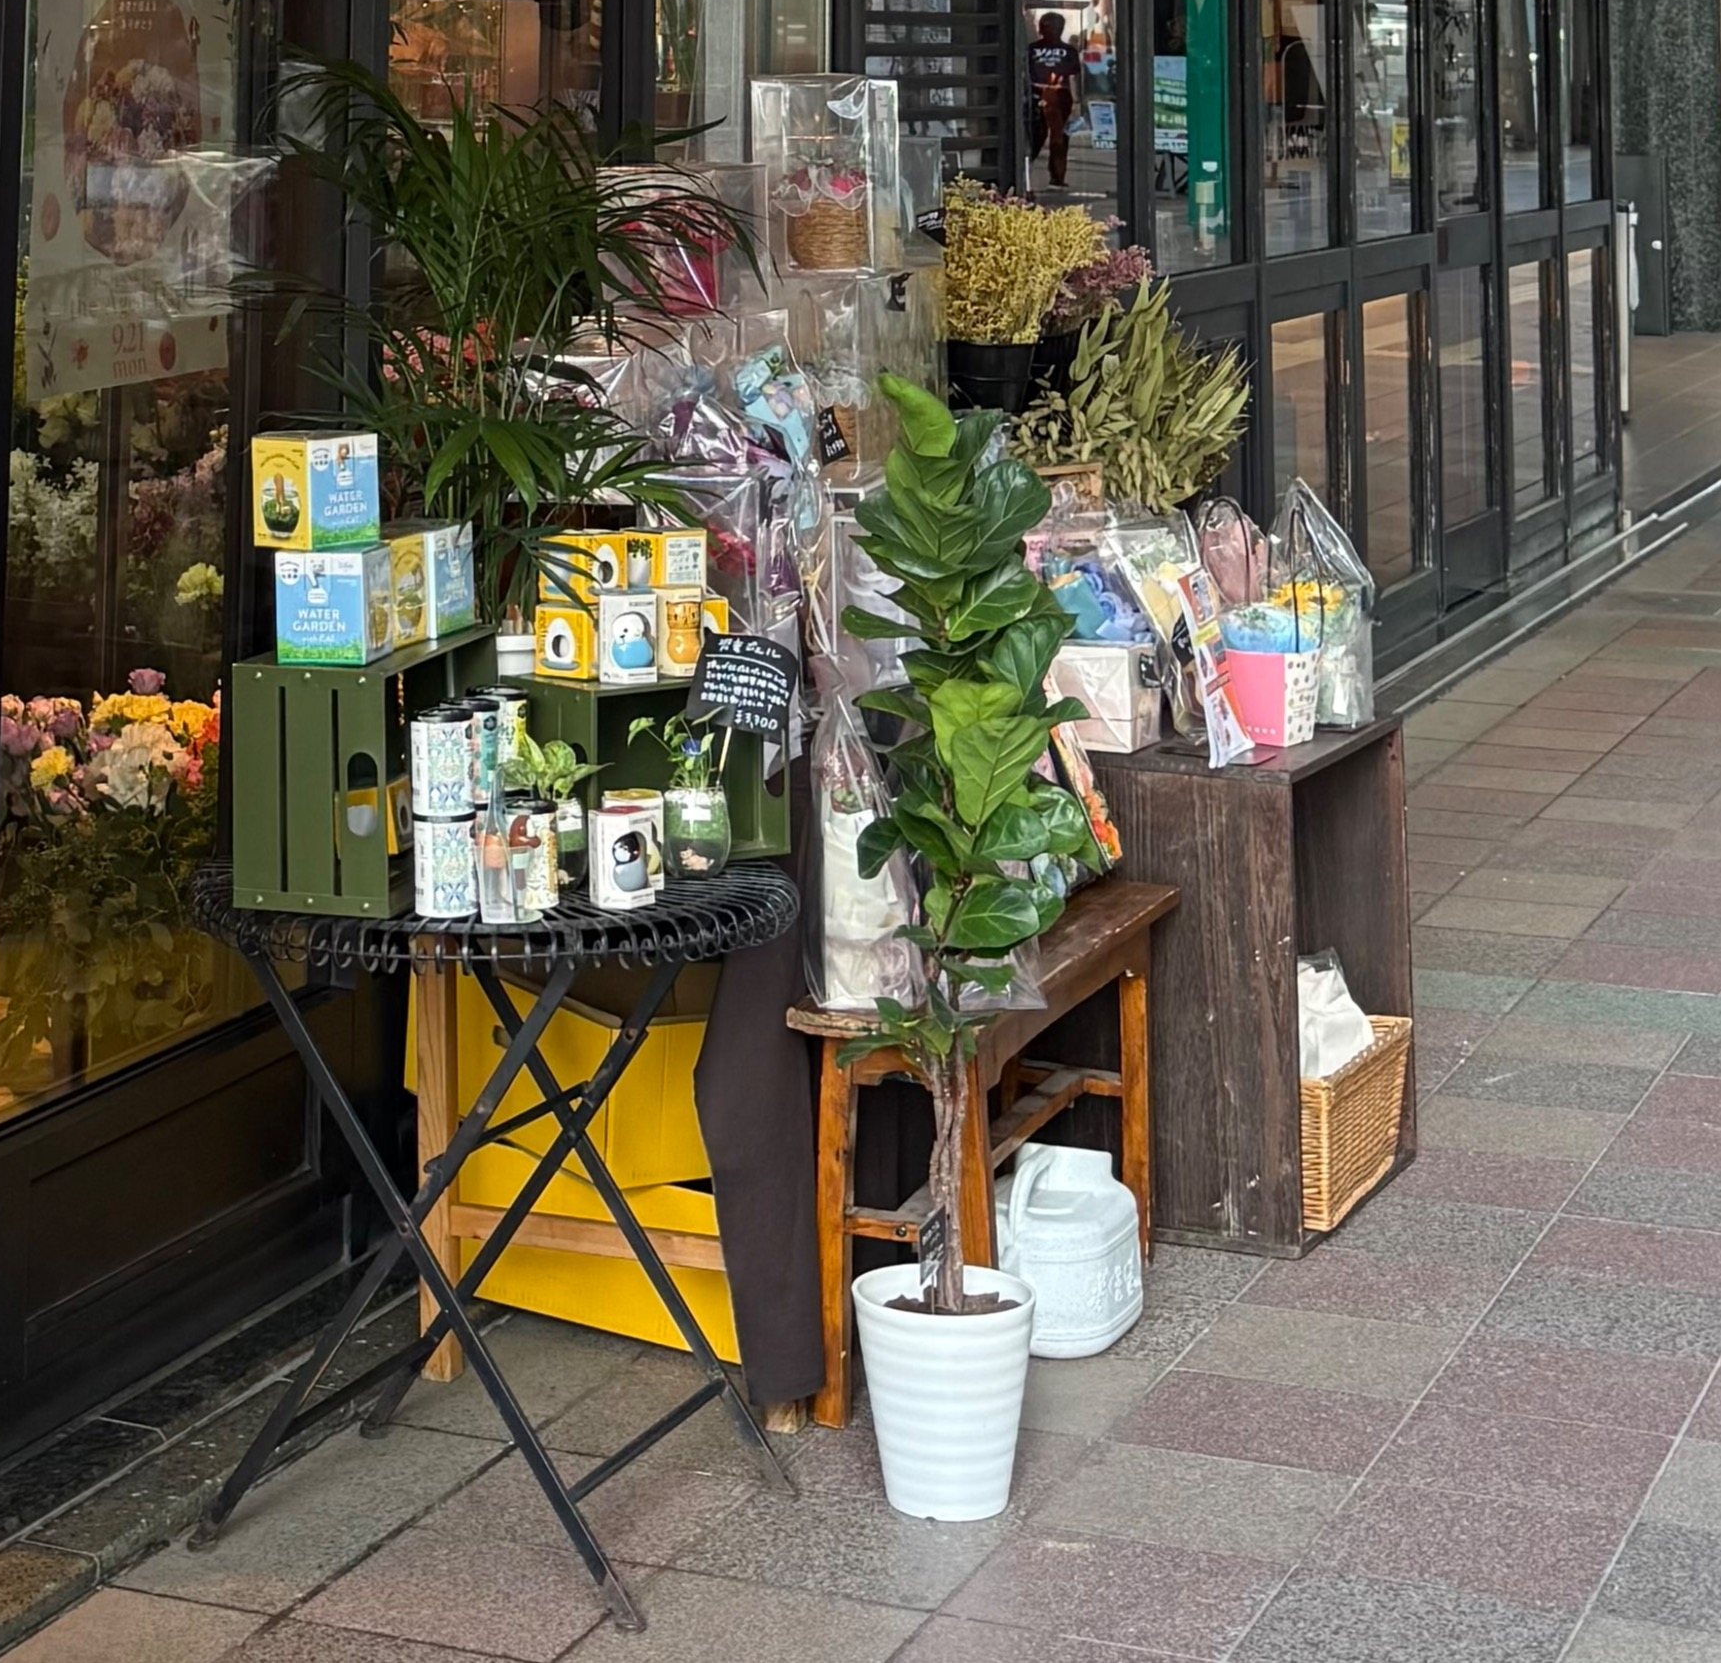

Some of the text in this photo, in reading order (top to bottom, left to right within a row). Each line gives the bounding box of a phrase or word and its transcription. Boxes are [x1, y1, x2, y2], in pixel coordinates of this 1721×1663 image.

[329, 490, 364, 503] WATER
[324, 502, 368, 517] GARDEN
[298, 608, 340, 620] WATER
[292, 620, 346, 632] GARDEN
